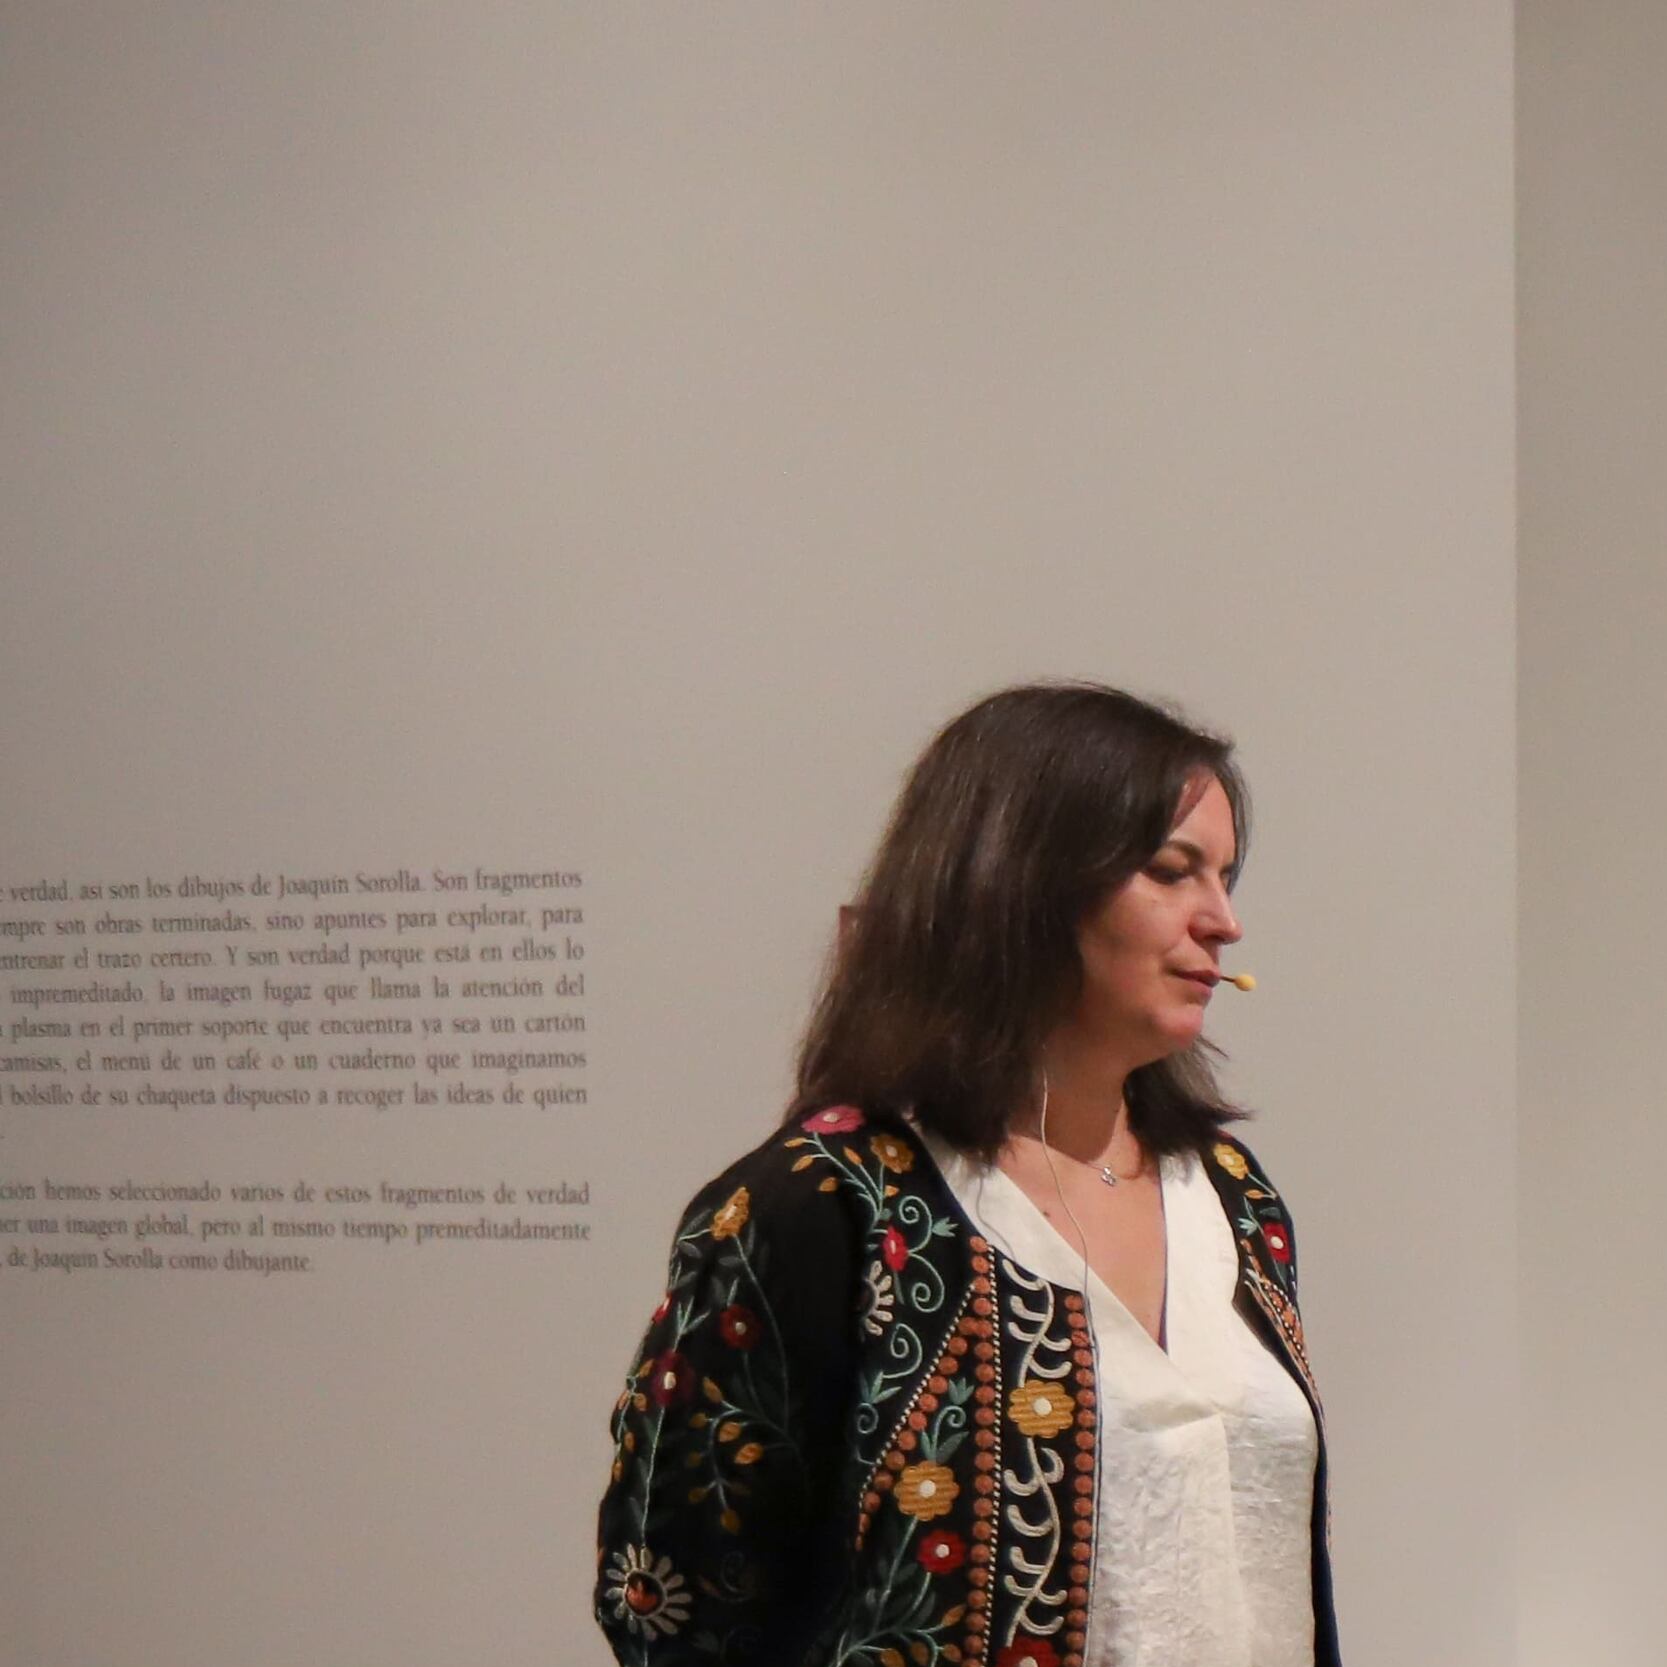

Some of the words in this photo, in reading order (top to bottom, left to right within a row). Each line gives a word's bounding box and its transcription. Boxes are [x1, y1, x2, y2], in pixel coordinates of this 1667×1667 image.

[107, 884, 140, 900] son
[145, 876, 173, 899] los
[177, 874, 246, 904] dibujos
[247, 874, 272, 896] de
[432, 869, 469, 892] Son
[473, 866, 583, 898] fragmentos
[72, 947, 89, 969] el
[95, 951, 143, 970] trazo
[224, 944, 238, 967] Y
[246, 950, 280, 966] son
[286, 942, 351, 966] verdad
[358, 946, 425, 970] porque
[478, 945, 504, 963] en
[511, 937, 557, 962] ellos
[564, 937, 585, 960] lo
[8, 1084, 75, 1105] bolsillo
[78, 1082, 103, 1105] de
[108, 1090, 130, 1106] su
[135, 1083, 217, 1112] chaqueta
[222, 1083, 311, 1112] dispuesto
[317, 1089, 329, 1105] a
[335, 1088, 405, 1111] recoger
[412, 1082, 439, 1105] las
[445, 1082, 495, 1105] ideas
[501, 1082, 525, 1105] de
[532, 1083, 588, 1111] quien
[43, 1178, 102, 1201] hemos
[108, 1179, 222, 1202] seleccionado
[229, 1184, 285, 1202] varios
[292, 1180, 316, 1203] de
[323, 1186, 373, 1204] estos
[379, 1181, 486, 1210] fragmentos
[492, 1181, 517, 1206] de
[525, 1181, 591, 1205] verdad
